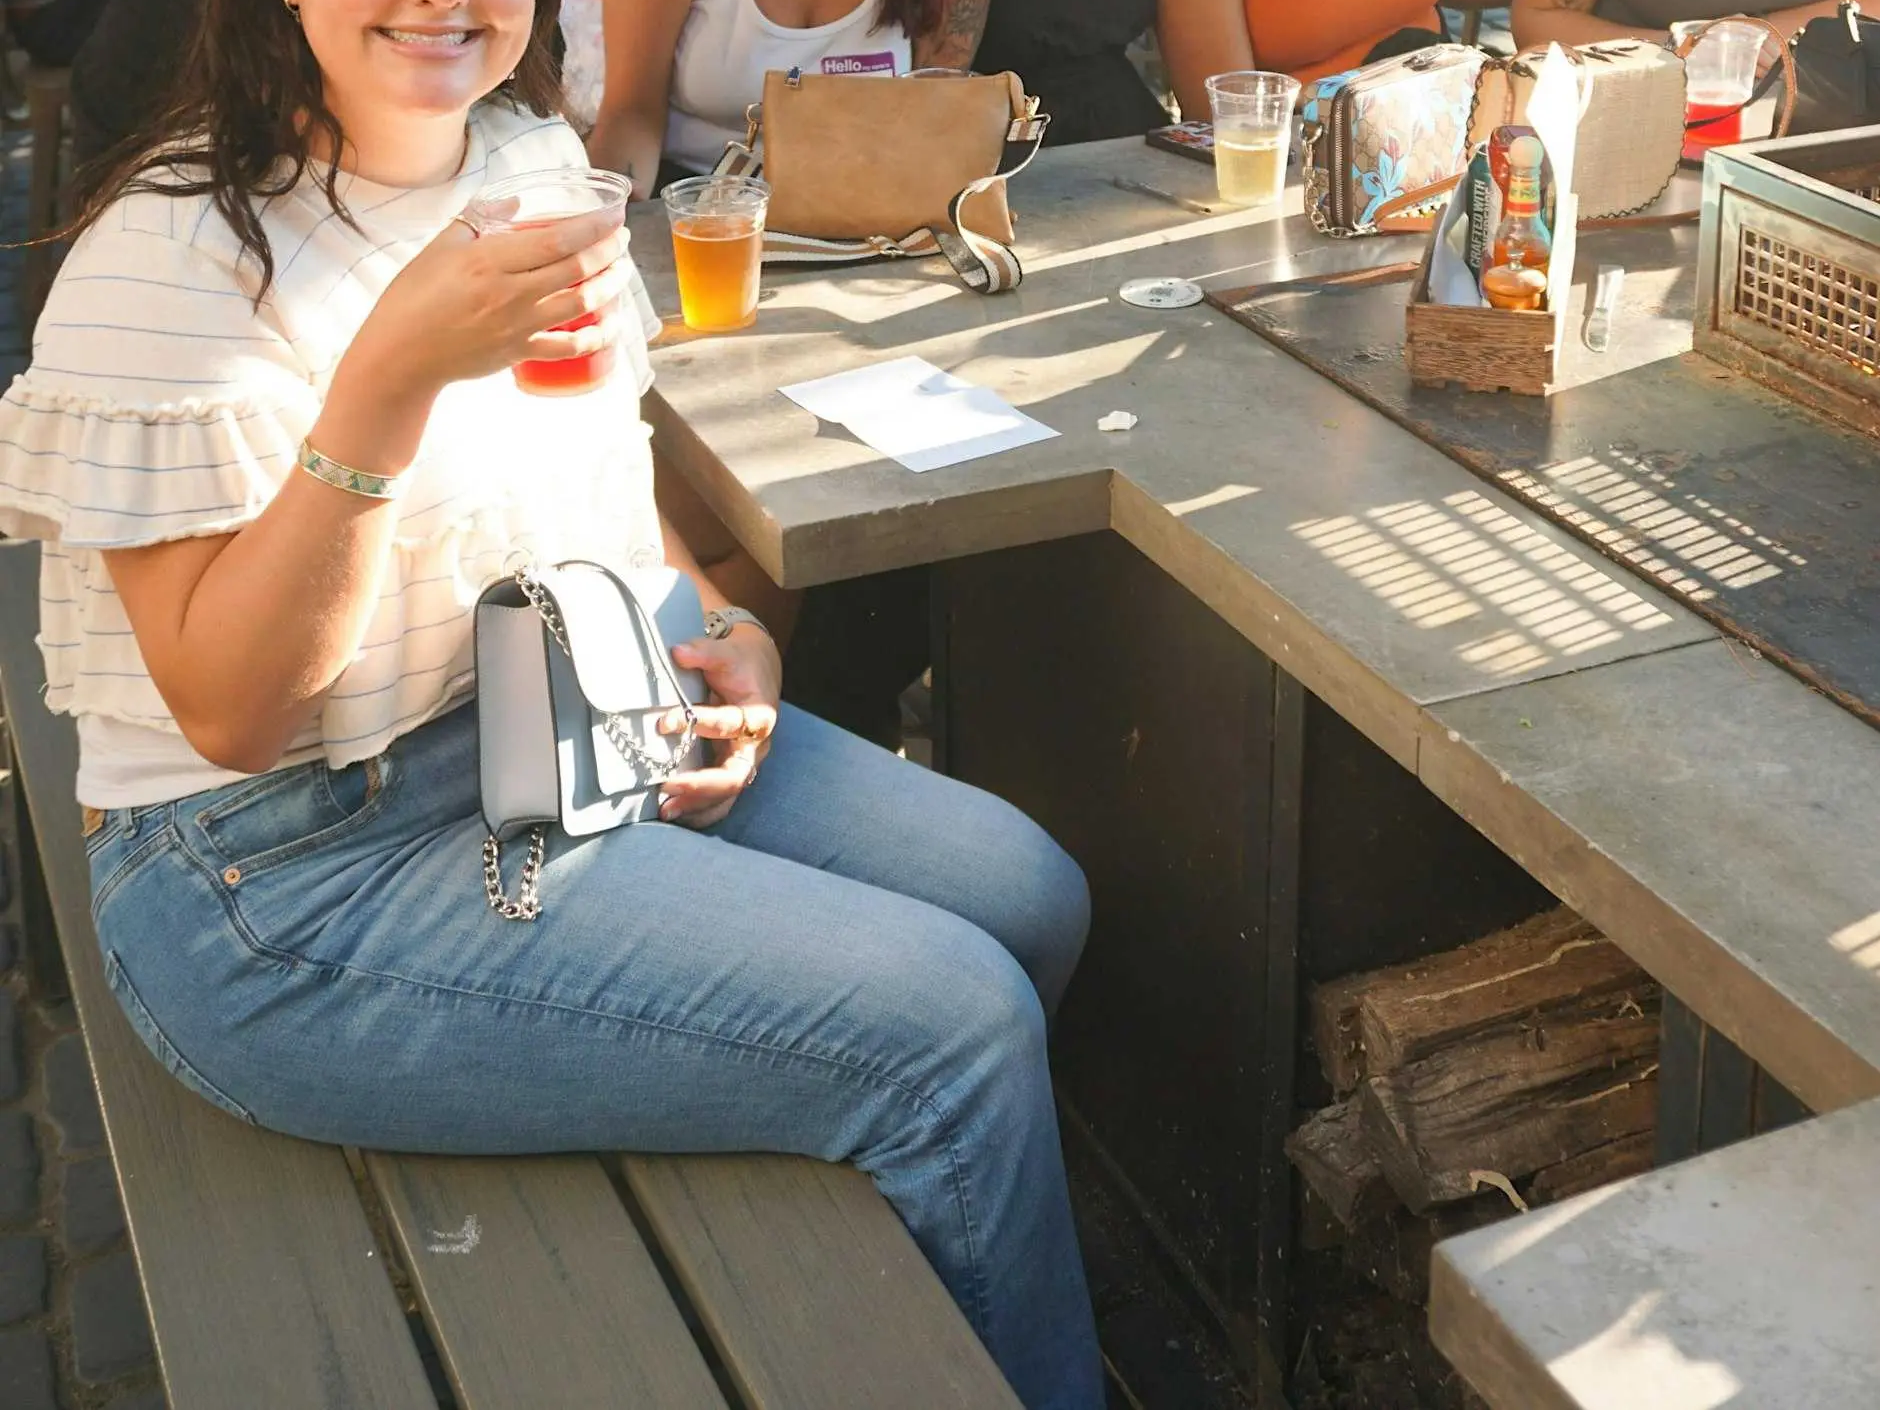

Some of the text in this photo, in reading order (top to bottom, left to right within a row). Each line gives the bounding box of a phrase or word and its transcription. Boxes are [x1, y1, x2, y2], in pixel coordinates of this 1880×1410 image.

[825, 59, 862, 73] Hello
[1469, 179, 1486, 268] CRAFTED WITH
